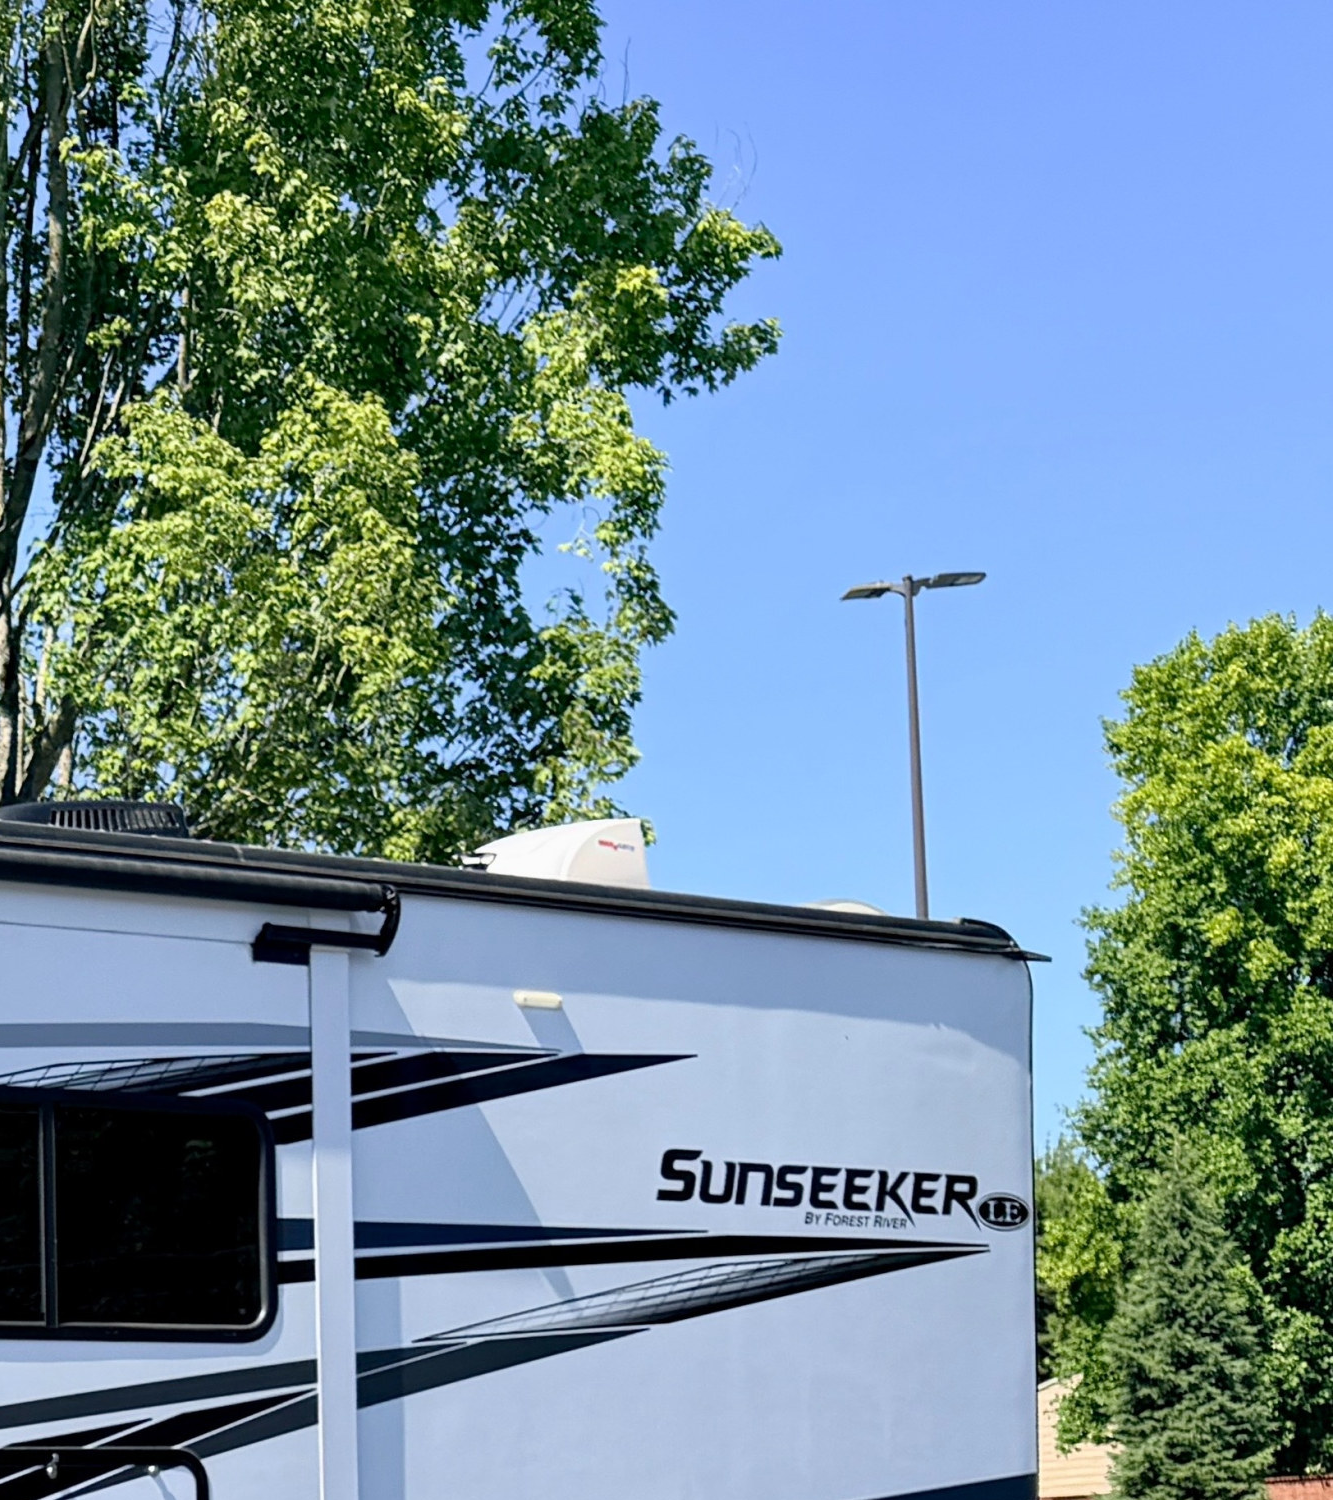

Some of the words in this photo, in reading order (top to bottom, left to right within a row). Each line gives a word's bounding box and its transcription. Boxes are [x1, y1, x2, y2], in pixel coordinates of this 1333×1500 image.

[824, 1212, 870, 1228] FOREST
[873, 1214, 908, 1229] RIVER
[986, 1200, 1022, 1223] LE
